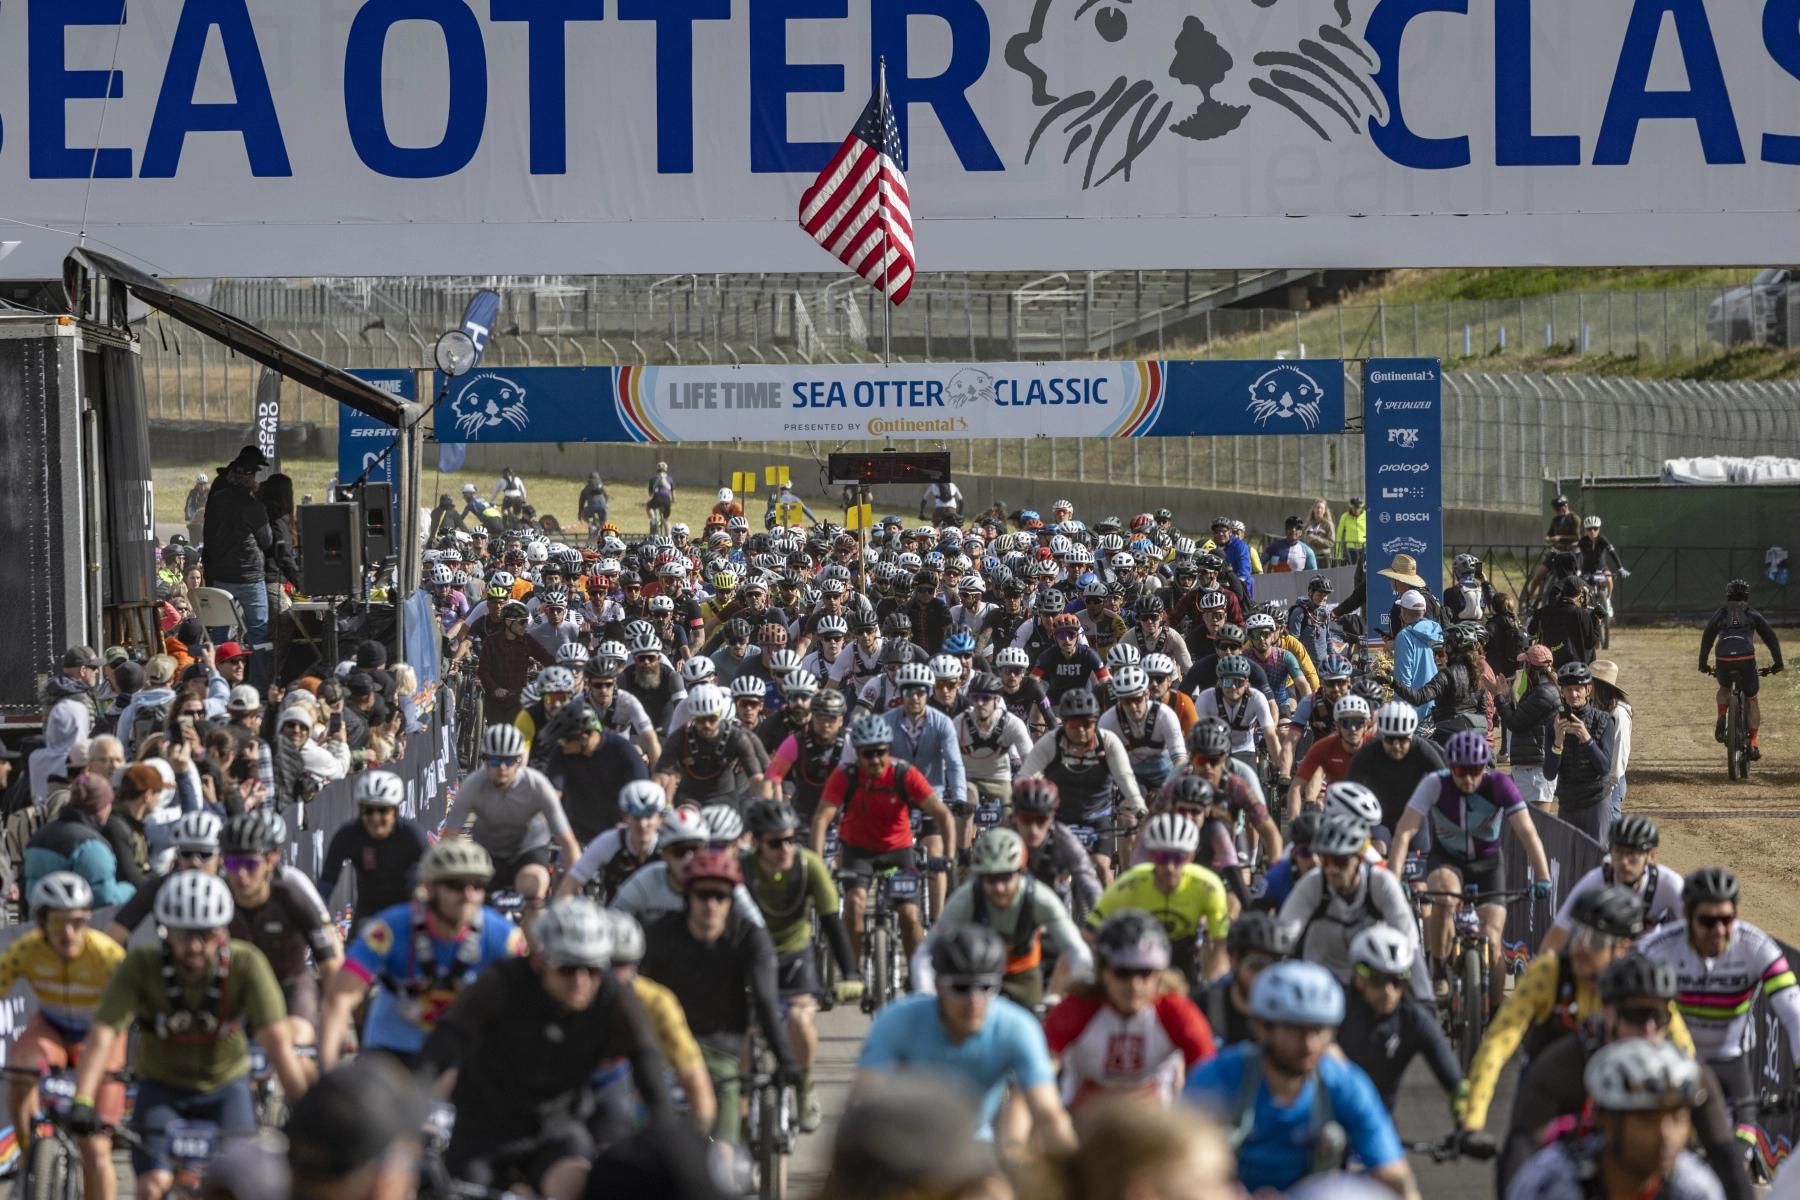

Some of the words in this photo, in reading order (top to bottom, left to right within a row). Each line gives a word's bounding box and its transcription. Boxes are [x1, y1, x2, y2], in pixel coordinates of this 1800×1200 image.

[0, 0, 293, 178] EA
[344, 0, 1006, 178] OTTER
[1370, 370, 1426, 384] Continental
[669, 383, 717, 409] LIFE
[720, 382, 781, 409] TIME
[792, 381, 847, 408] SEA
[853, 380, 945, 408] OTTER
[994, 377, 1108, 406] CLASSIC
[1384, 401, 1432, 410] SPECIALIZED
[266, 401, 279, 458] DEMO
[784, 423, 844, 431] PRESENTED
[848, 423, 861, 431] BY
[867, 416, 955, 436] Continental
[1388, 428, 1419, 442] FOX
[1395, 512, 1430, 522] BOSCH
